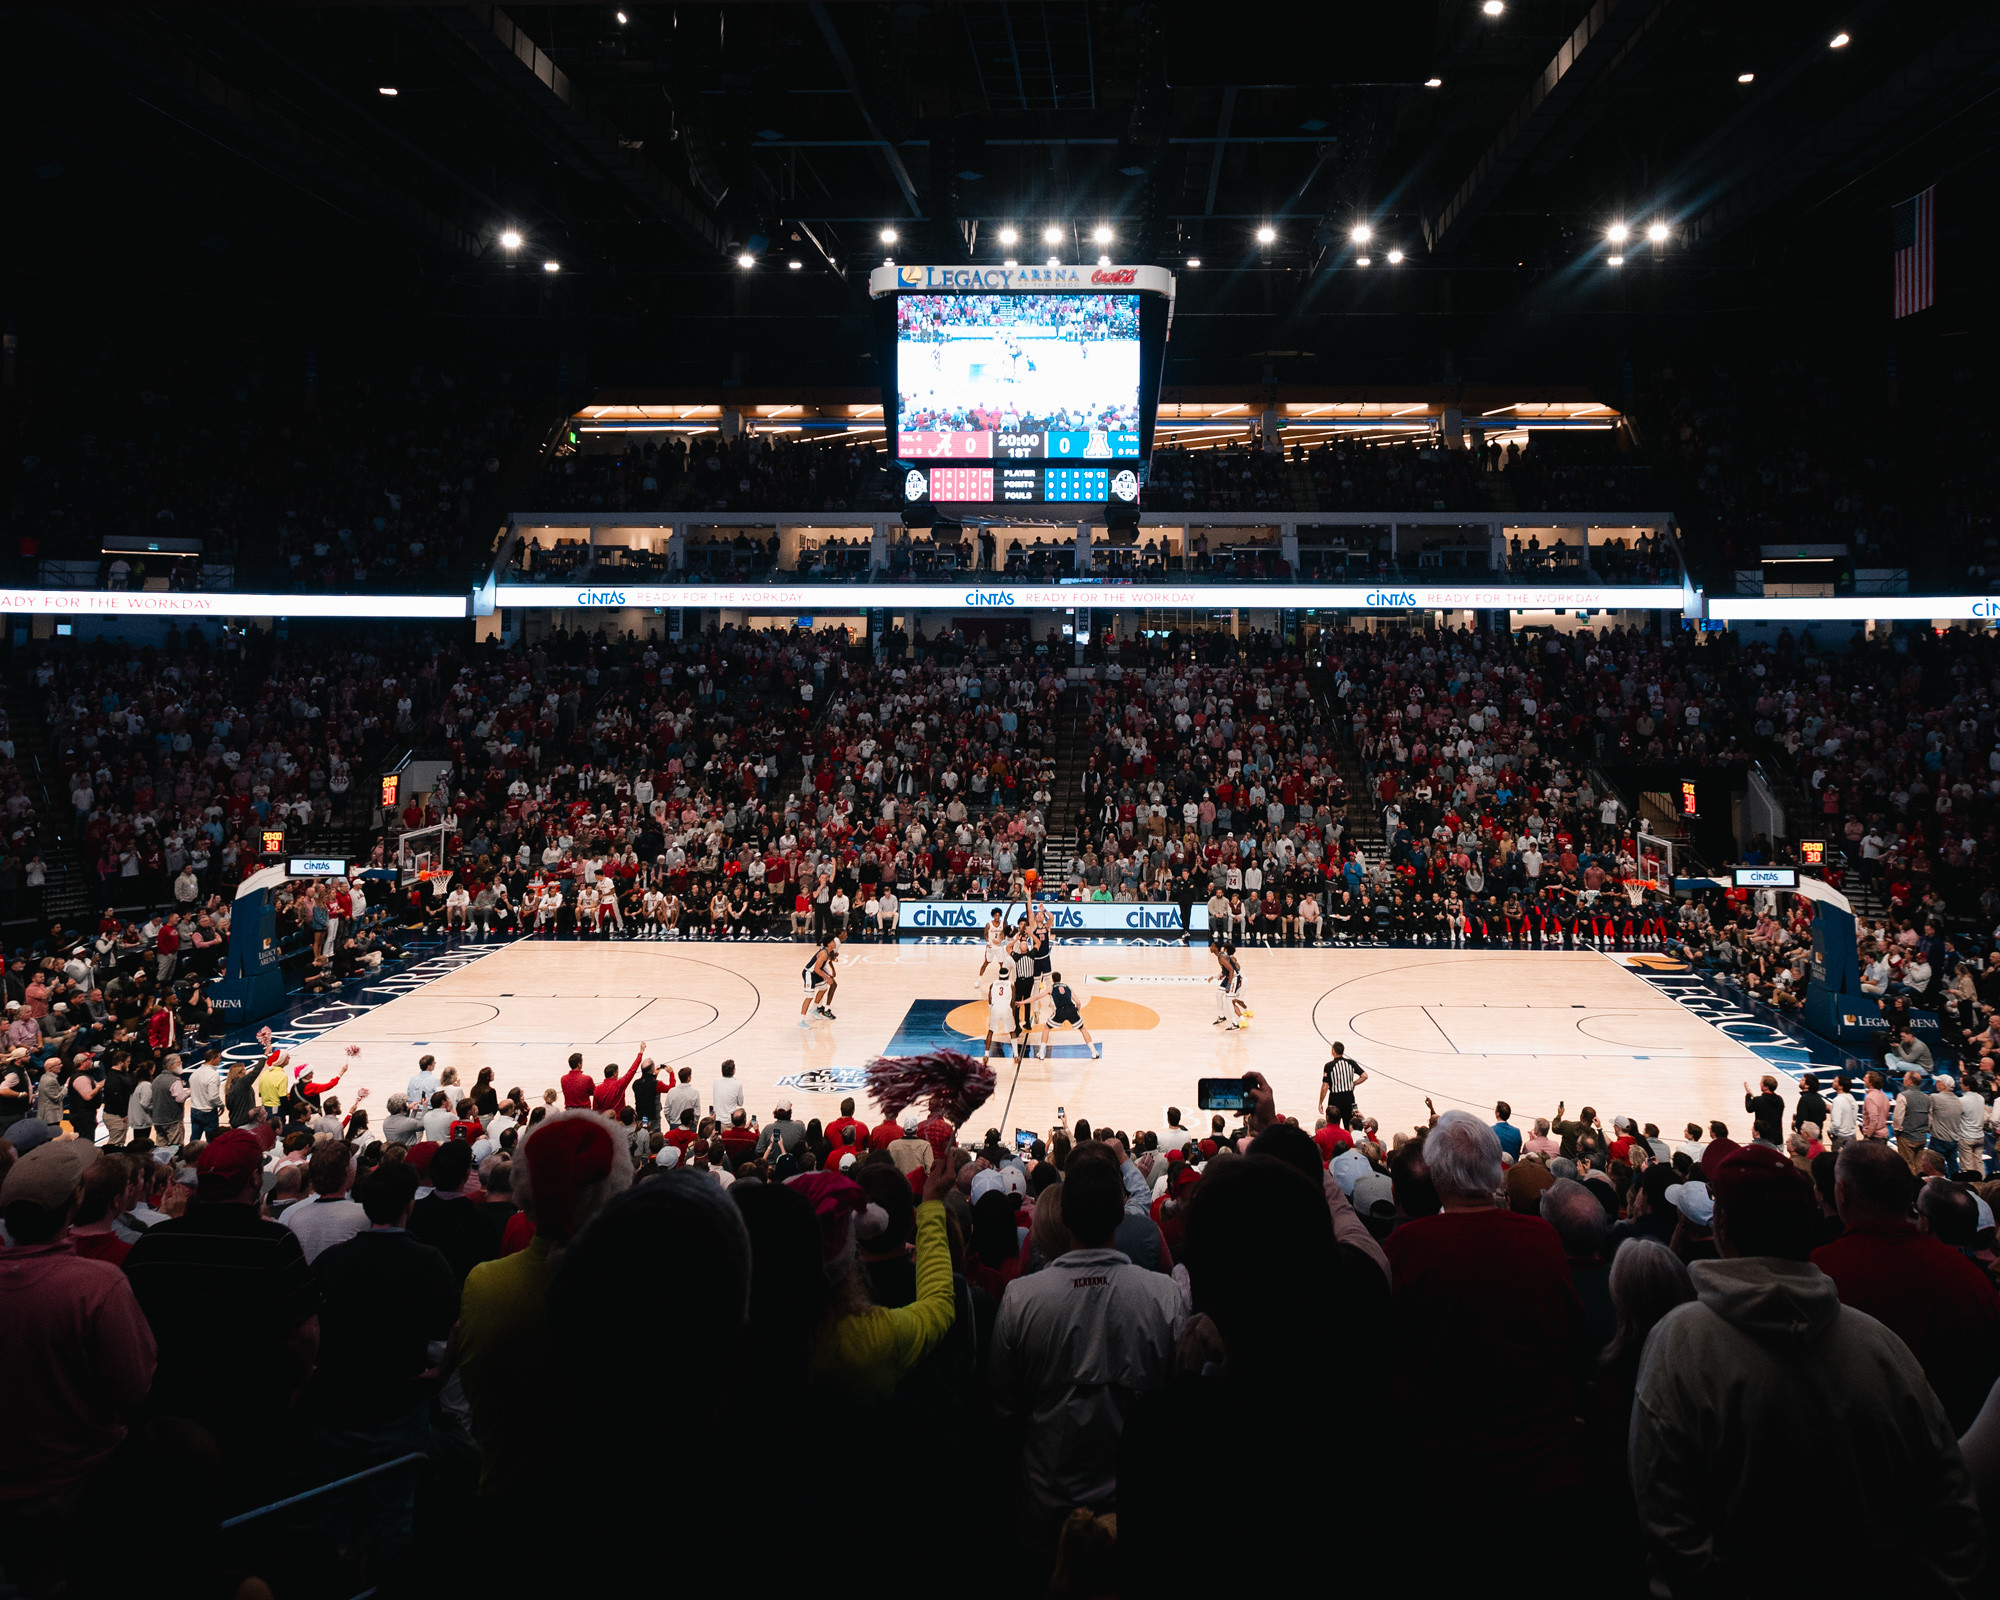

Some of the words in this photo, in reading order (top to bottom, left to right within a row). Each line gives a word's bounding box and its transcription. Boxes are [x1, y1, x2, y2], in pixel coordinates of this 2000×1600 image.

[926, 267, 1013, 289] LEGACY
[1018, 268, 1079, 282] ARENA
[965, 437, 976, 454] 0
[998, 434, 1039, 447] 20:00
[1059, 437, 1070, 454] 0
[1008, 447, 1031, 458] 1ST
[1003, 469, 1036, 477] PLAYER
[1, 596, 36, 607] ADY
[44, 597, 80, 608] FOR
[88, 598, 120, 608] THE
[128, 598, 213, 609] WORKDAY
[637, 592, 678, 602] READY
[684, 592, 708, 602] FOR
[713, 592, 735, 602] THE
[740, 592, 804, 602] WORKDAY
[1026, 592, 1067, 602] READY
[1073, 592, 1098, 602] FOR
[1103, 592, 1126, 602] THE
[1131, 592, 1196, 603] WORKDAY
[1427, 593, 1469, 603] READY
[1474, 593, 1501, 603] FOR
[1506, 593, 1529, 603] THE
[1535, 593, 1600, 603] WORKDAY
[383, 786, 396, 806] 30
[1684, 794, 1696, 813] 30
[263, 832, 282, 840] 20:00
[266, 840, 279, 851] 30
[1802, 842, 1823, 851] 20:00
[1806, 851, 1821, 862] 30
[1126, 906, 1184, 928] CINTA
[919, 935, 1185, 946] BIRGHAM
[362, 942, 513, 995] ARENA
[999, 986, 1004, 996] 3
[1635, 972, 1814, 1053] LEGACY
[1858, 1015, 1891, 1027] LEGA
[1909, 1018, 1938, 1028] RENA
[1073, 1276, 1108, 1288] ALABAMA
